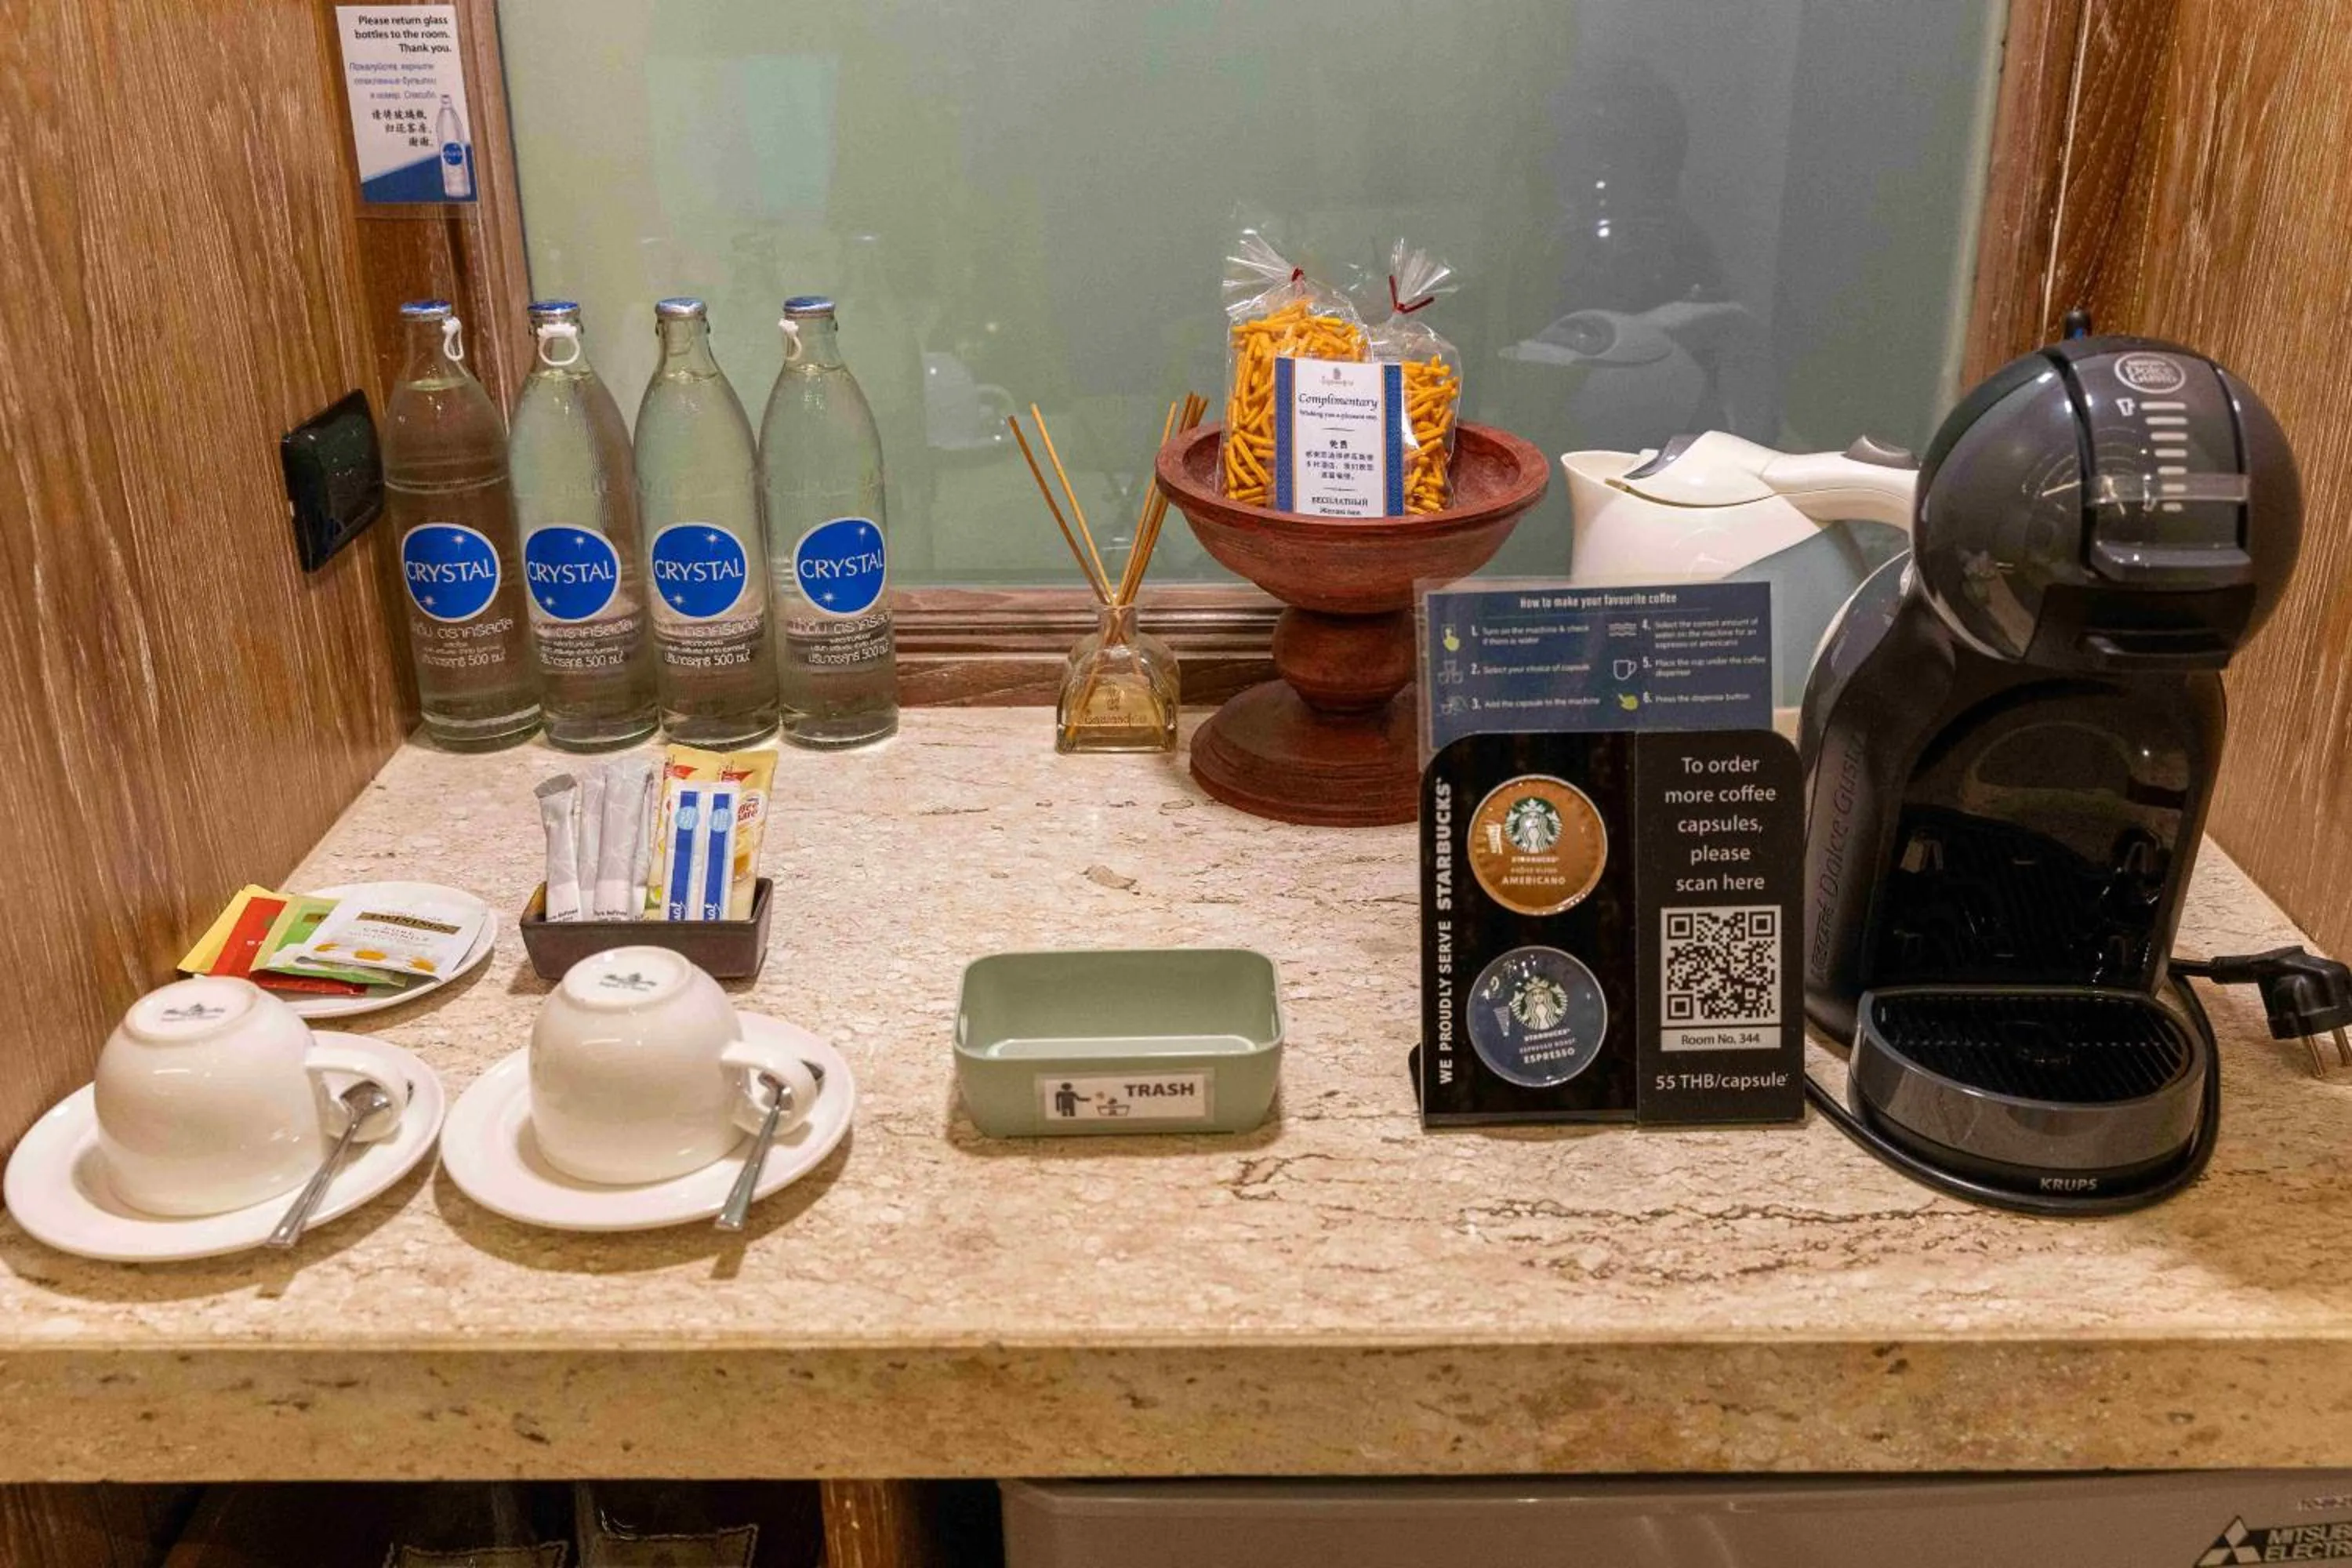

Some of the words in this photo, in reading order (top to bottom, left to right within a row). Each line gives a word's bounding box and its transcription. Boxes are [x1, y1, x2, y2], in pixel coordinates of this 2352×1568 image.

[358, 15, 390, 25] Please
[392, 16, 421, 25] return
[423, 15, 448, 27] glass
[354, 29, 389, 38] bottles
[390, 30, 401, 38] to
[403, 29, 419, 38] the
[398, 43, 429, 53] Thank
[430, 45, 452, 53] you.
[1298, 393, 1377, 412] Complimentary
[404, 558, 495, 583] CRYSTAL
[527, 560, 615, 584] CRYSTAL
[655, 557, 742, 582] CRYSTAL
[800, 549, 884, 579] CRYSTAL
[1520, 597, 1539, 608] How
[1542, 597, 1551, 608] to
[1554, 596, 1578, 608] make
[1580, 596, 1602, 609] your
[1604, 593, 1646, 606] favourite
[1649, 593, 1677, 604] coffee
[469, 653, 488, 666] 500
[586, 655, 605, 666] 500
[714, 654, 734, 666] 500
[862, 646, 879, 659] 500
[1471, 662, 1481, 675] 2.
[1681, 757, 1704, 774] To
[1708, 755, 1760, 772] order
[1664, 789, 1714, 804] more
[1719, 784, 1777, 802] coffee
[1678, 814, 1763, 837] capsules,
[1690, 844, 1751, 866] please
[1819, 819, 1849, 899] Dolce
[1502, 877, 1566, 885] AMERICANO
[1676, 877, 1718, 891] scan
[1722, 873, 1765, 890] here
[1438, 920, 1452, 975] SERVE
[1439, 978, 1453, 1051] PROUDLY
[1681, 1034, 1715, 1045] Room
[1718, 1033, 1736, 1044] No.
[1740, 1033, 1760, 1044] 344
[1523, 1047, 1575, 1064] ESPRESSO
[1439, 1059, 1453, 1085] WE
[1123, 1082, 1195, 1097] TRASH
[1655, 1074, 1675, 1091] 55
[2040, 1177, 2098, 1191] KRUPS
